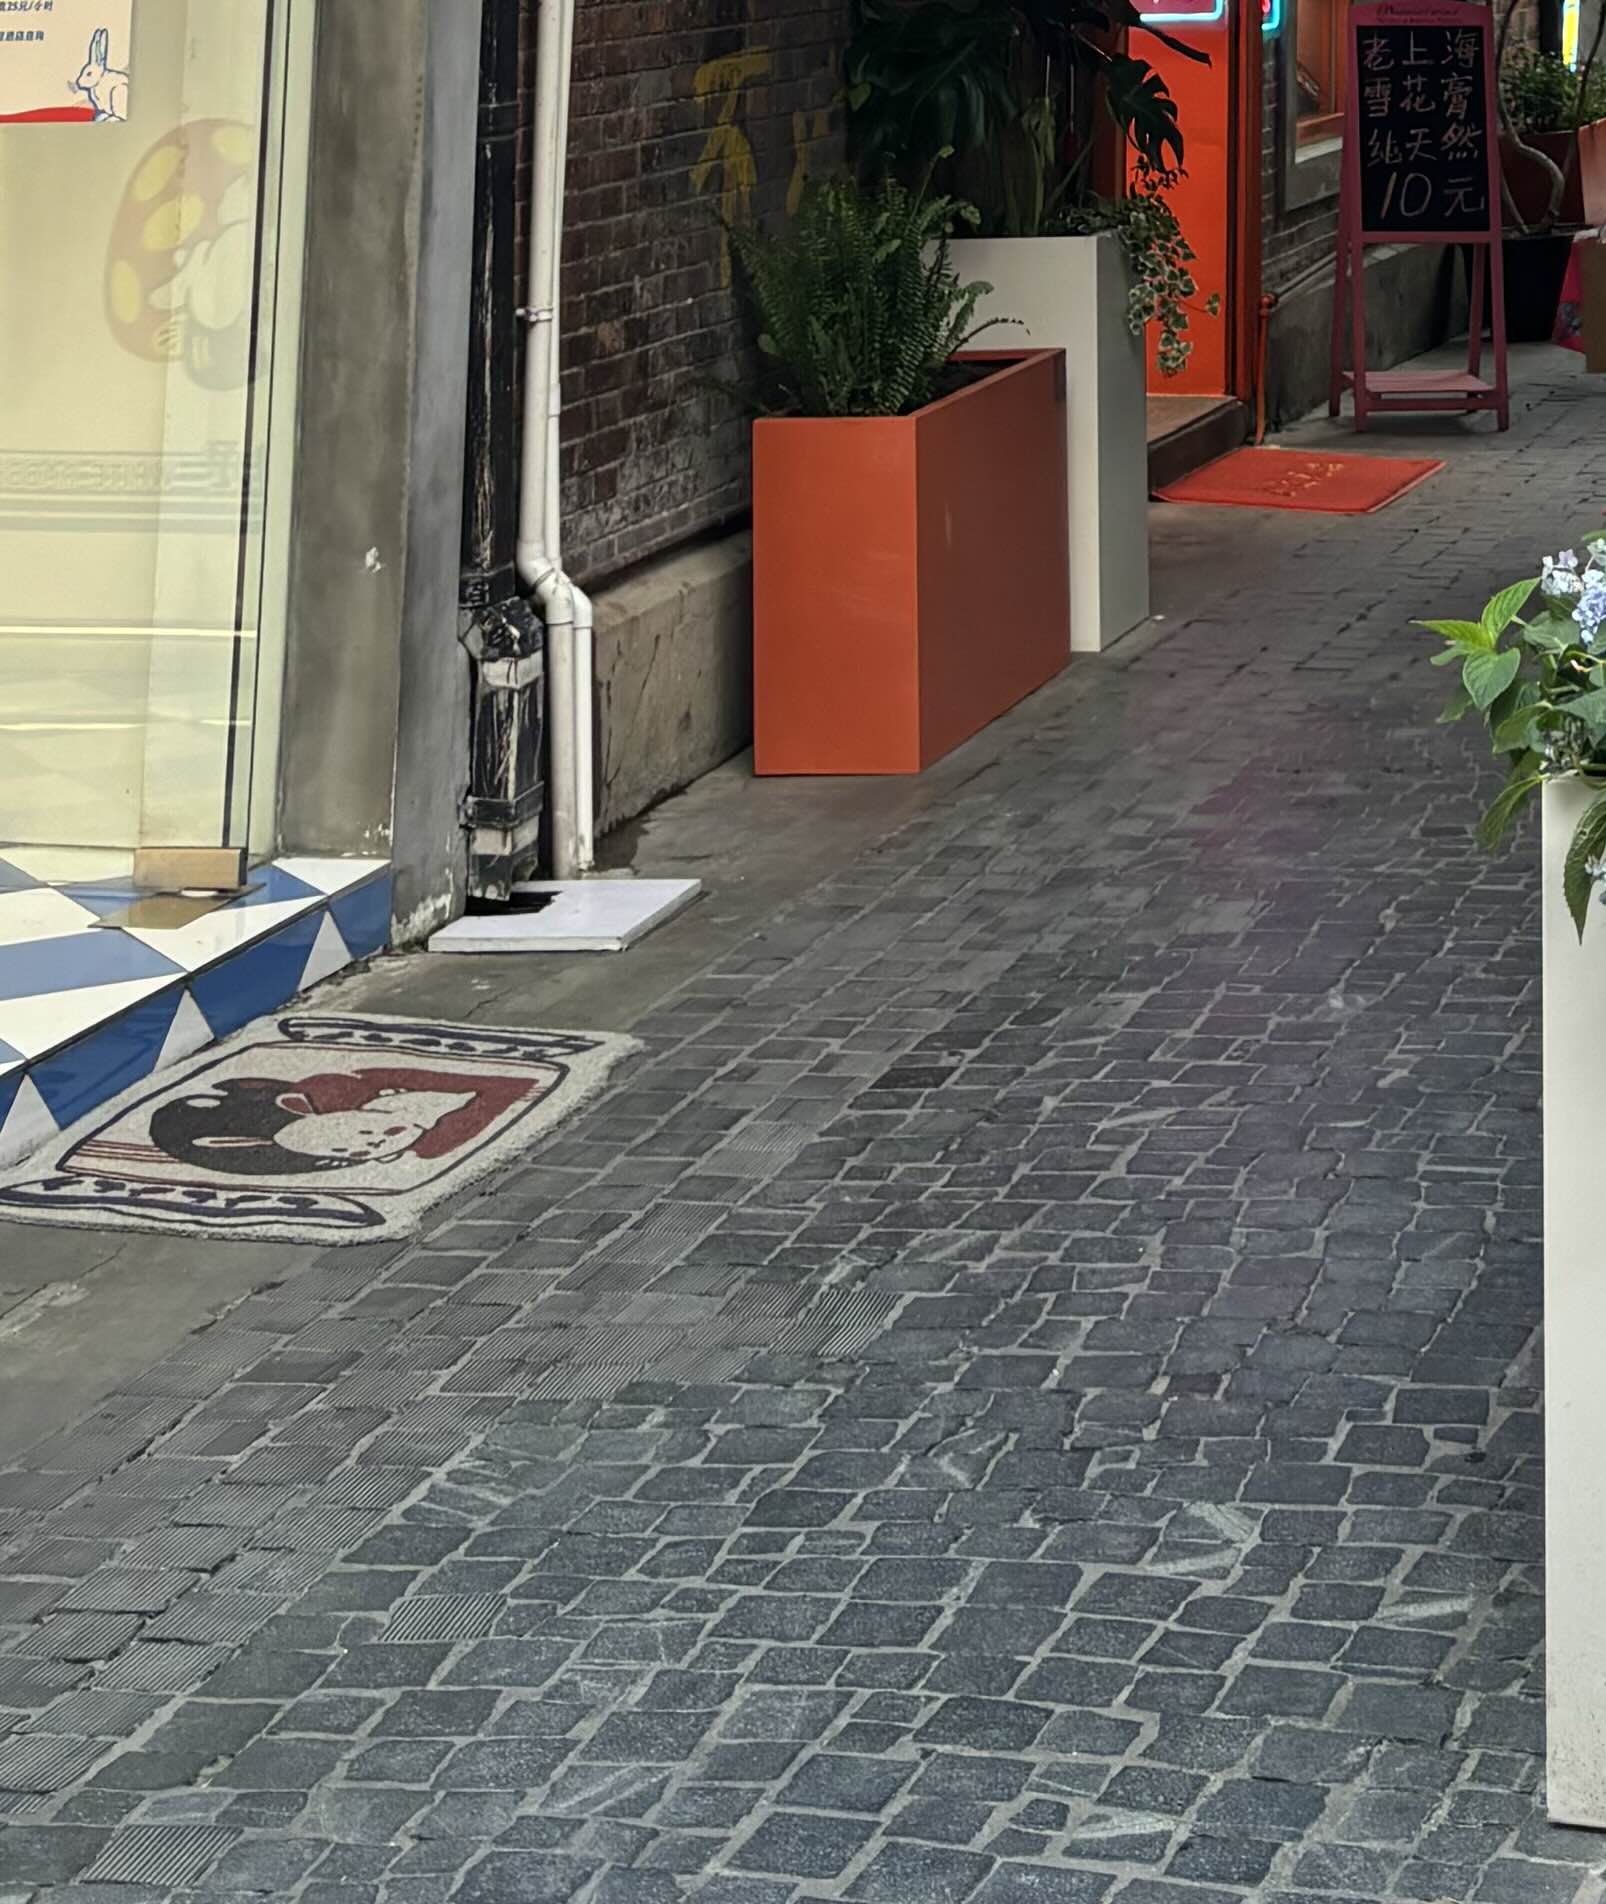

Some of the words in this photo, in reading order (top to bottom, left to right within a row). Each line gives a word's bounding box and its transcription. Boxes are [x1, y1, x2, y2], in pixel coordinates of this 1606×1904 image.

[1363, 31, 1480, 70] 老上海
[1363, 72, 1474, 120] 雪花膏
